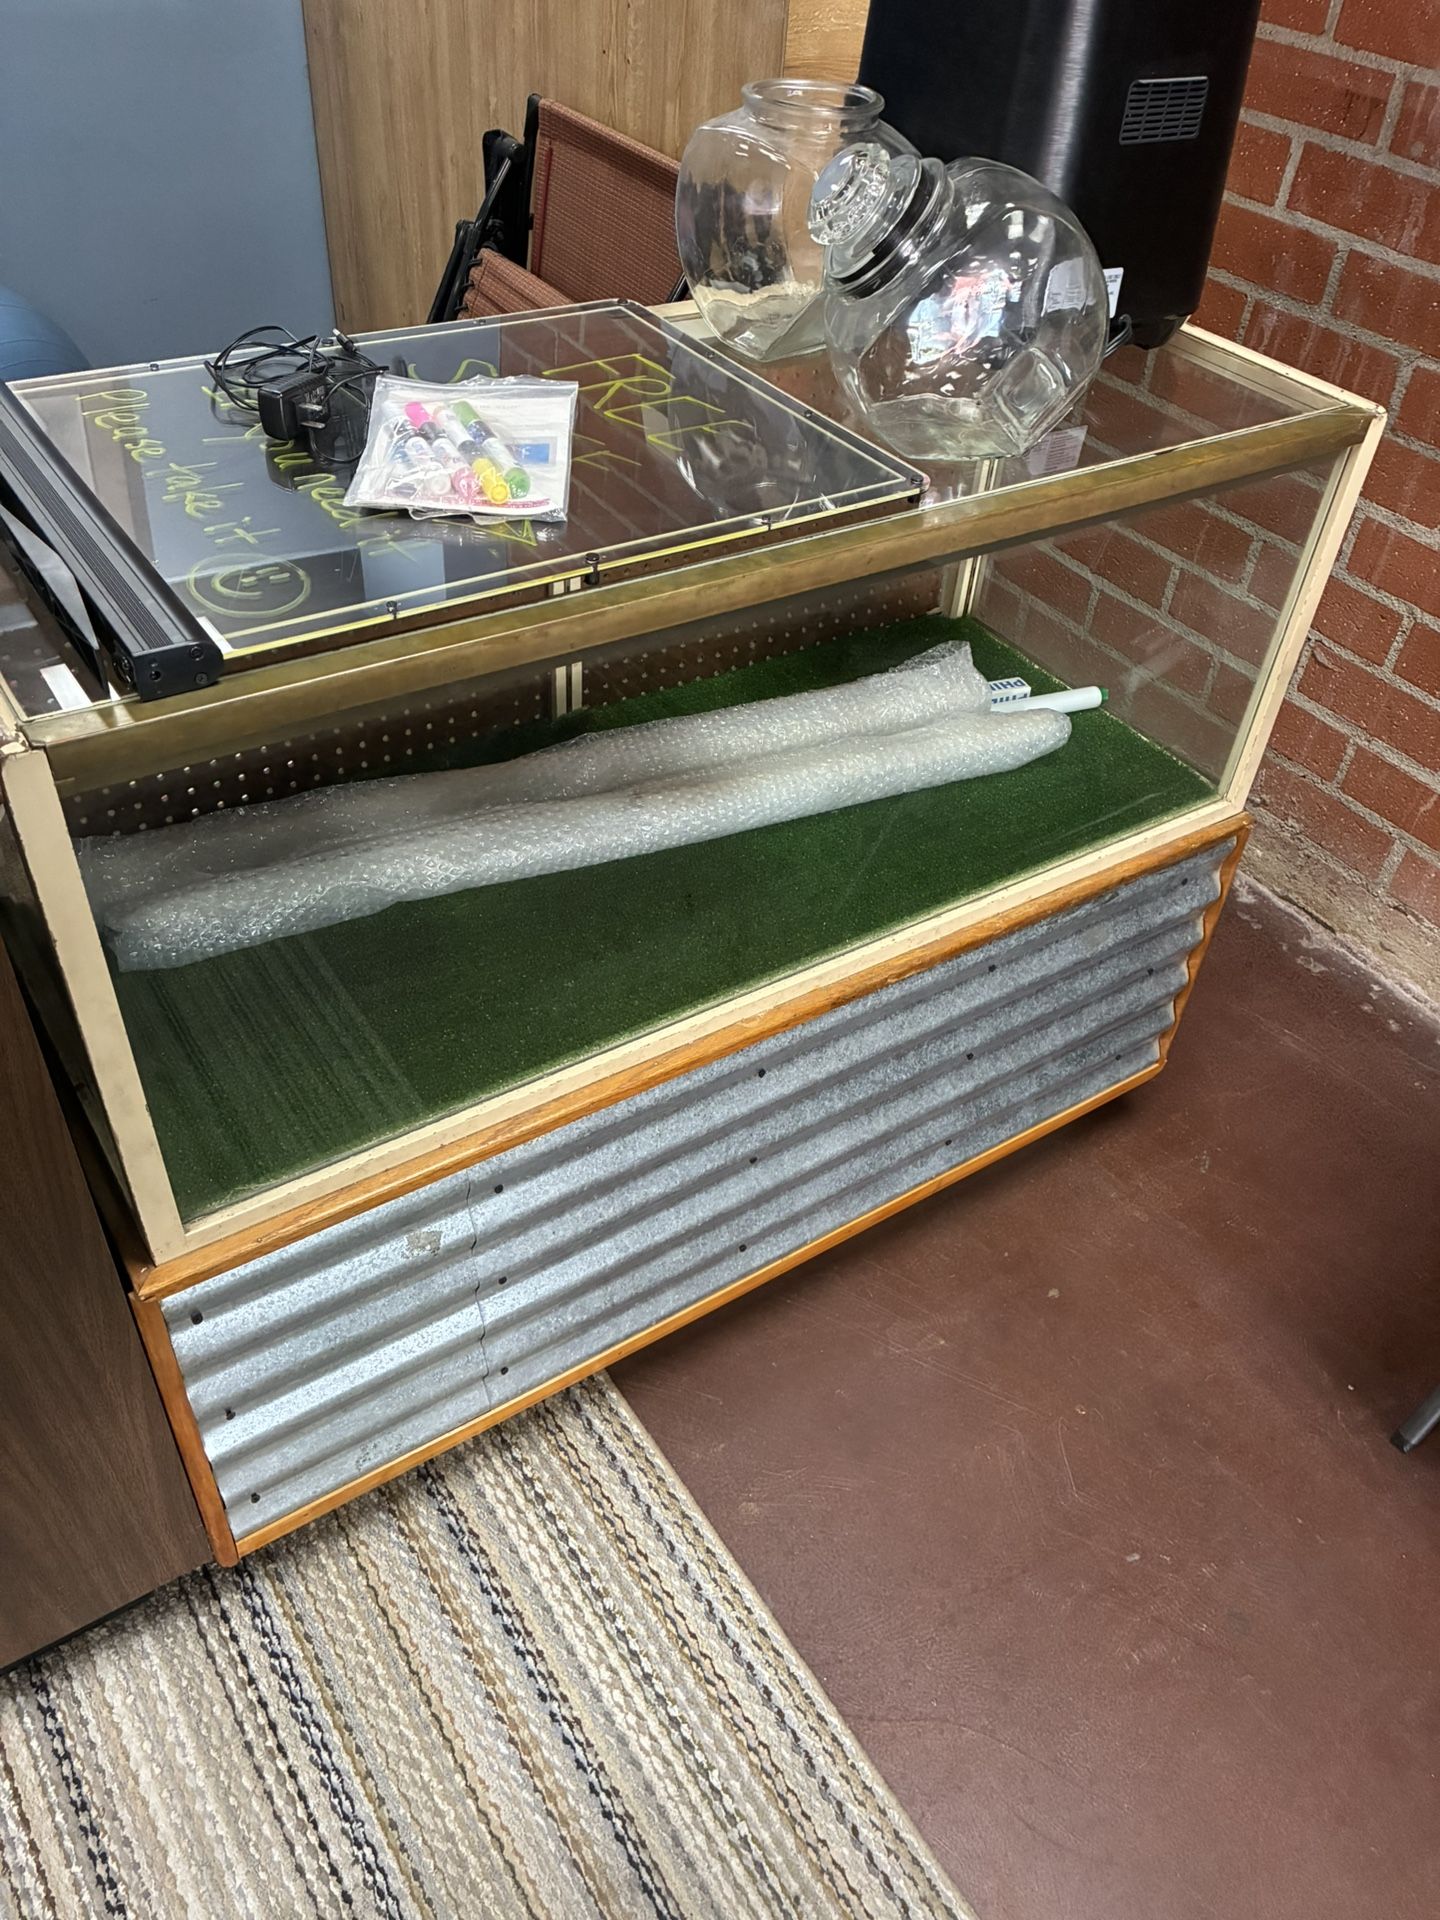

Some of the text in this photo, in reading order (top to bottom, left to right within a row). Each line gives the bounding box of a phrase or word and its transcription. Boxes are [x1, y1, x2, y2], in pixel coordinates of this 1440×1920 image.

[542, 353, 753, 452] FREE
[74, 388, 282, 544] Please take it
[293, 472, 400, 529] need
